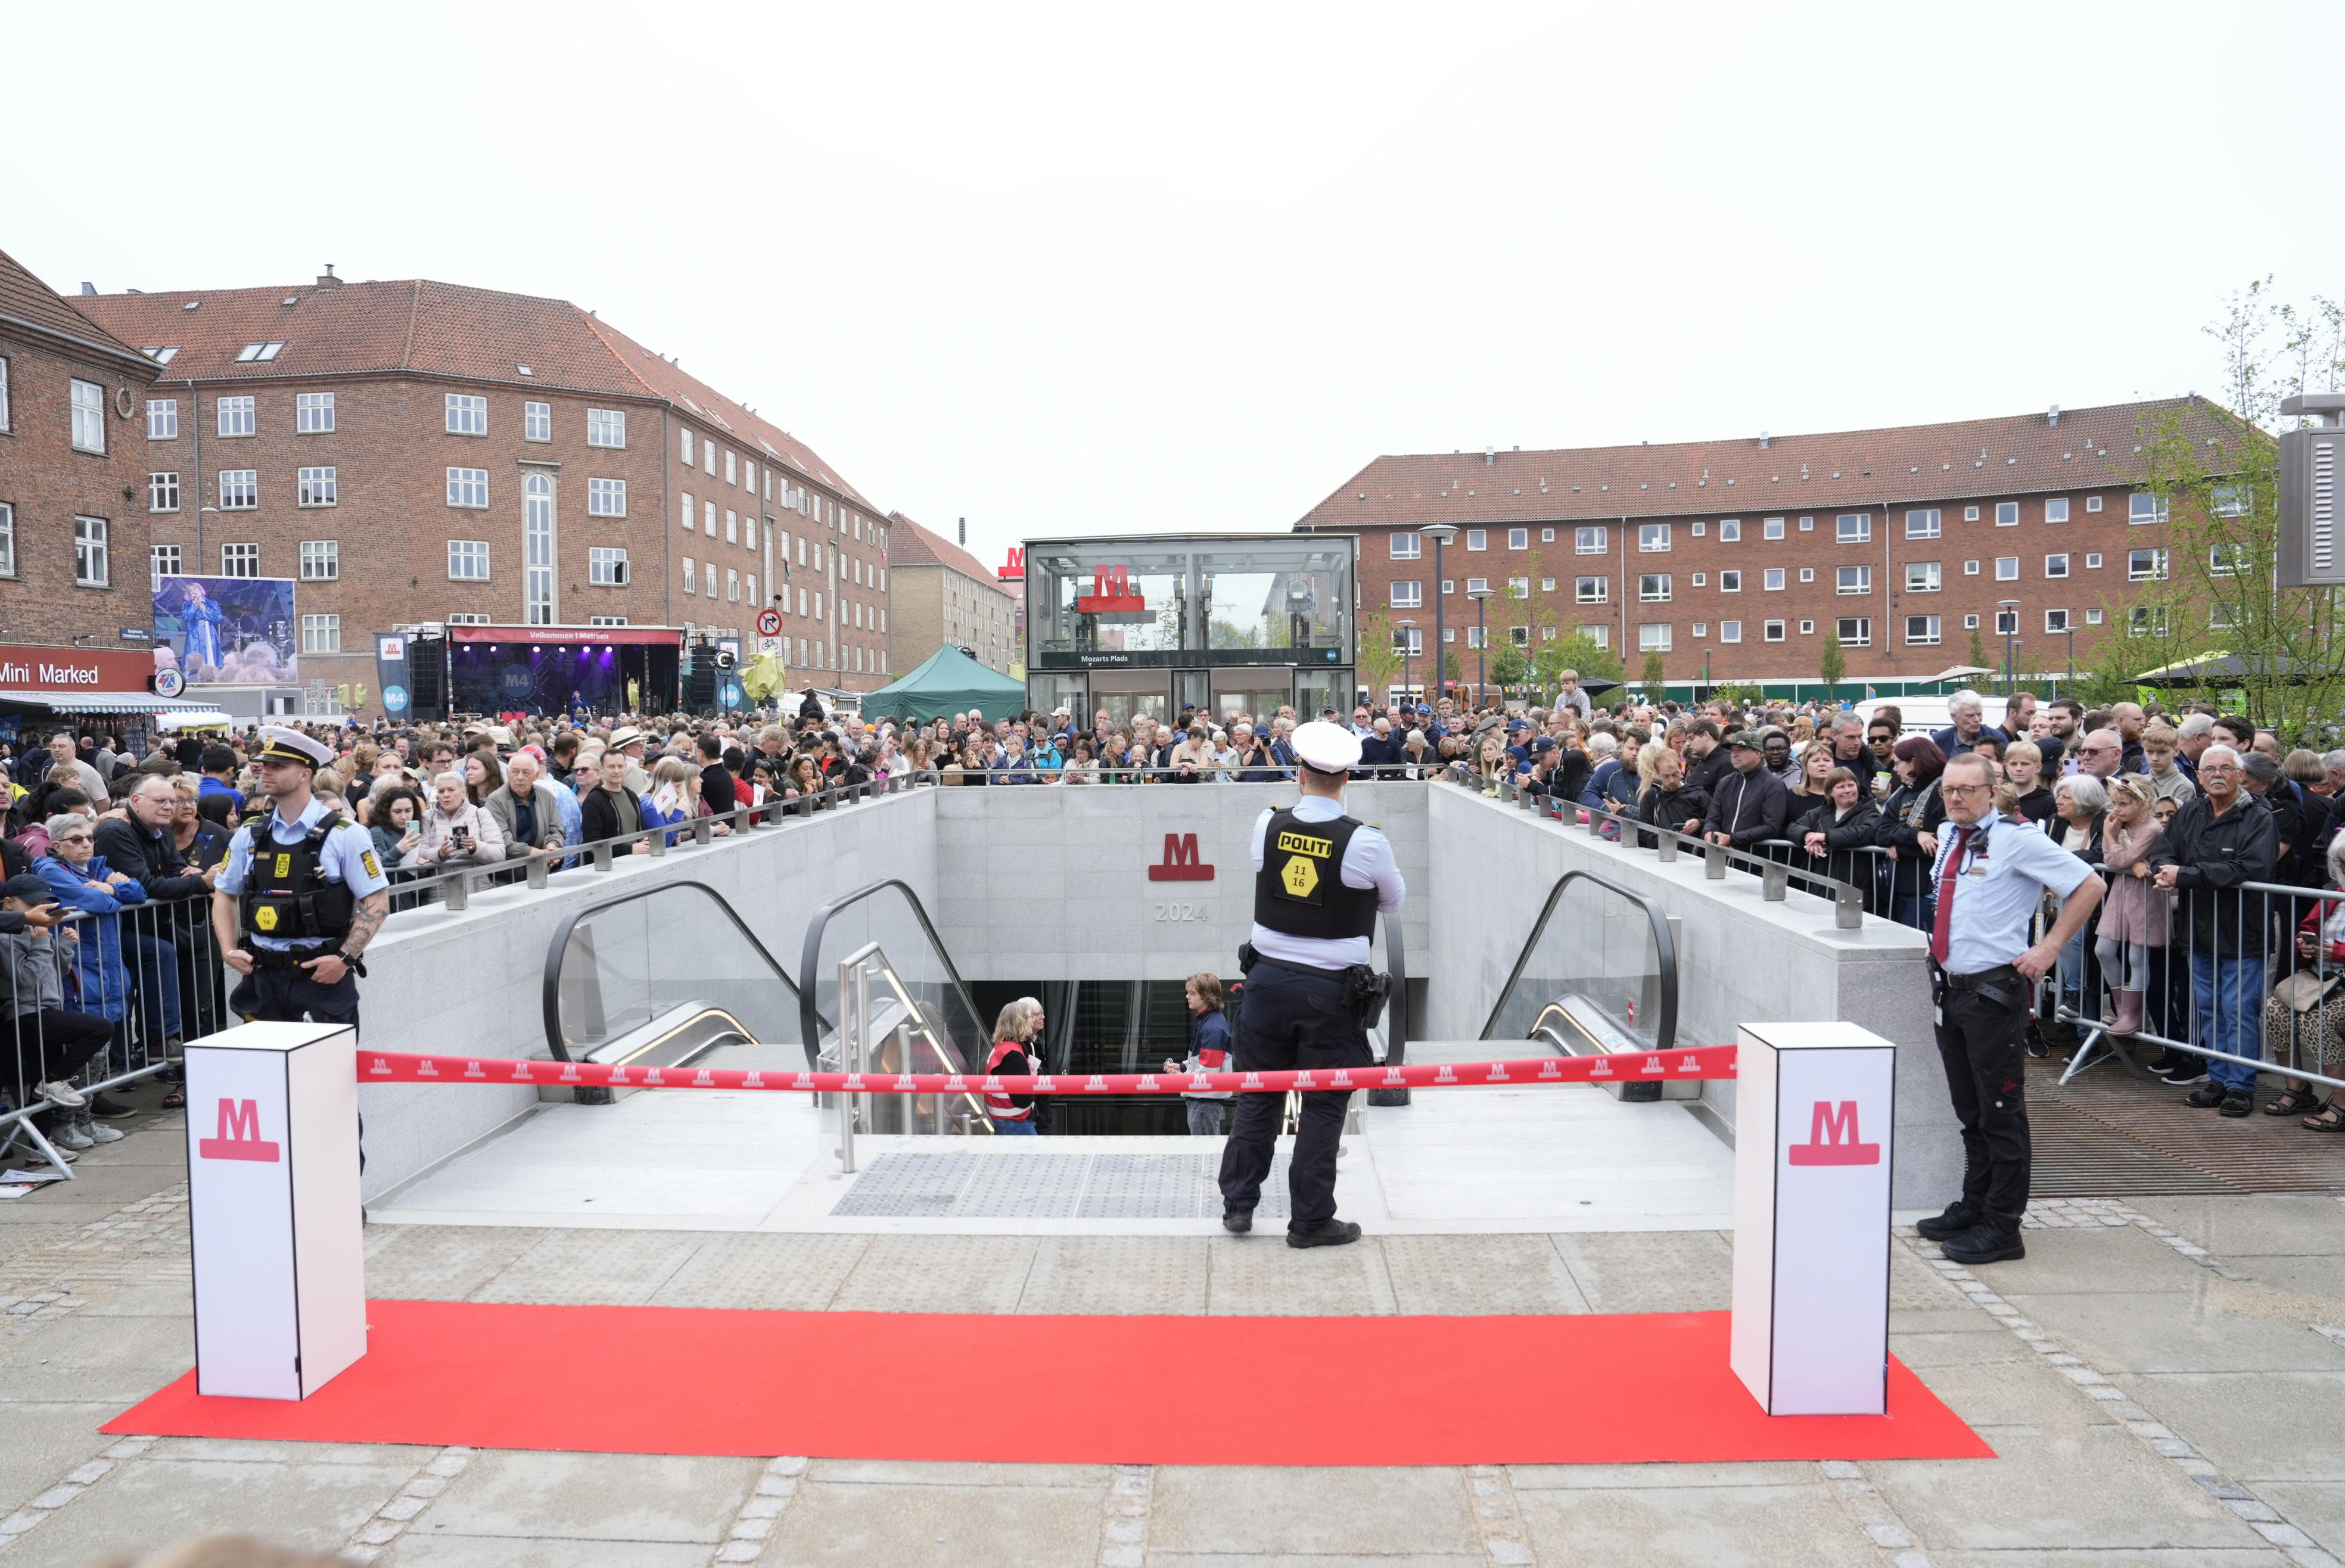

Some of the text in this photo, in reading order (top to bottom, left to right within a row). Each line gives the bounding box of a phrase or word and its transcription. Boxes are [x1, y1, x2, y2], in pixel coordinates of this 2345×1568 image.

[0, 662, 98, 685] Mini Marked
[505, 674, 529, 687] M4
[386, 693, 405, 704] M4
[1280, 835, 1332, 855] POLITI
[1294, 865, 1306, 876] 11
[1292, 877, 1305, 888] 16
[1155, 903, 1208, 922] 2024
